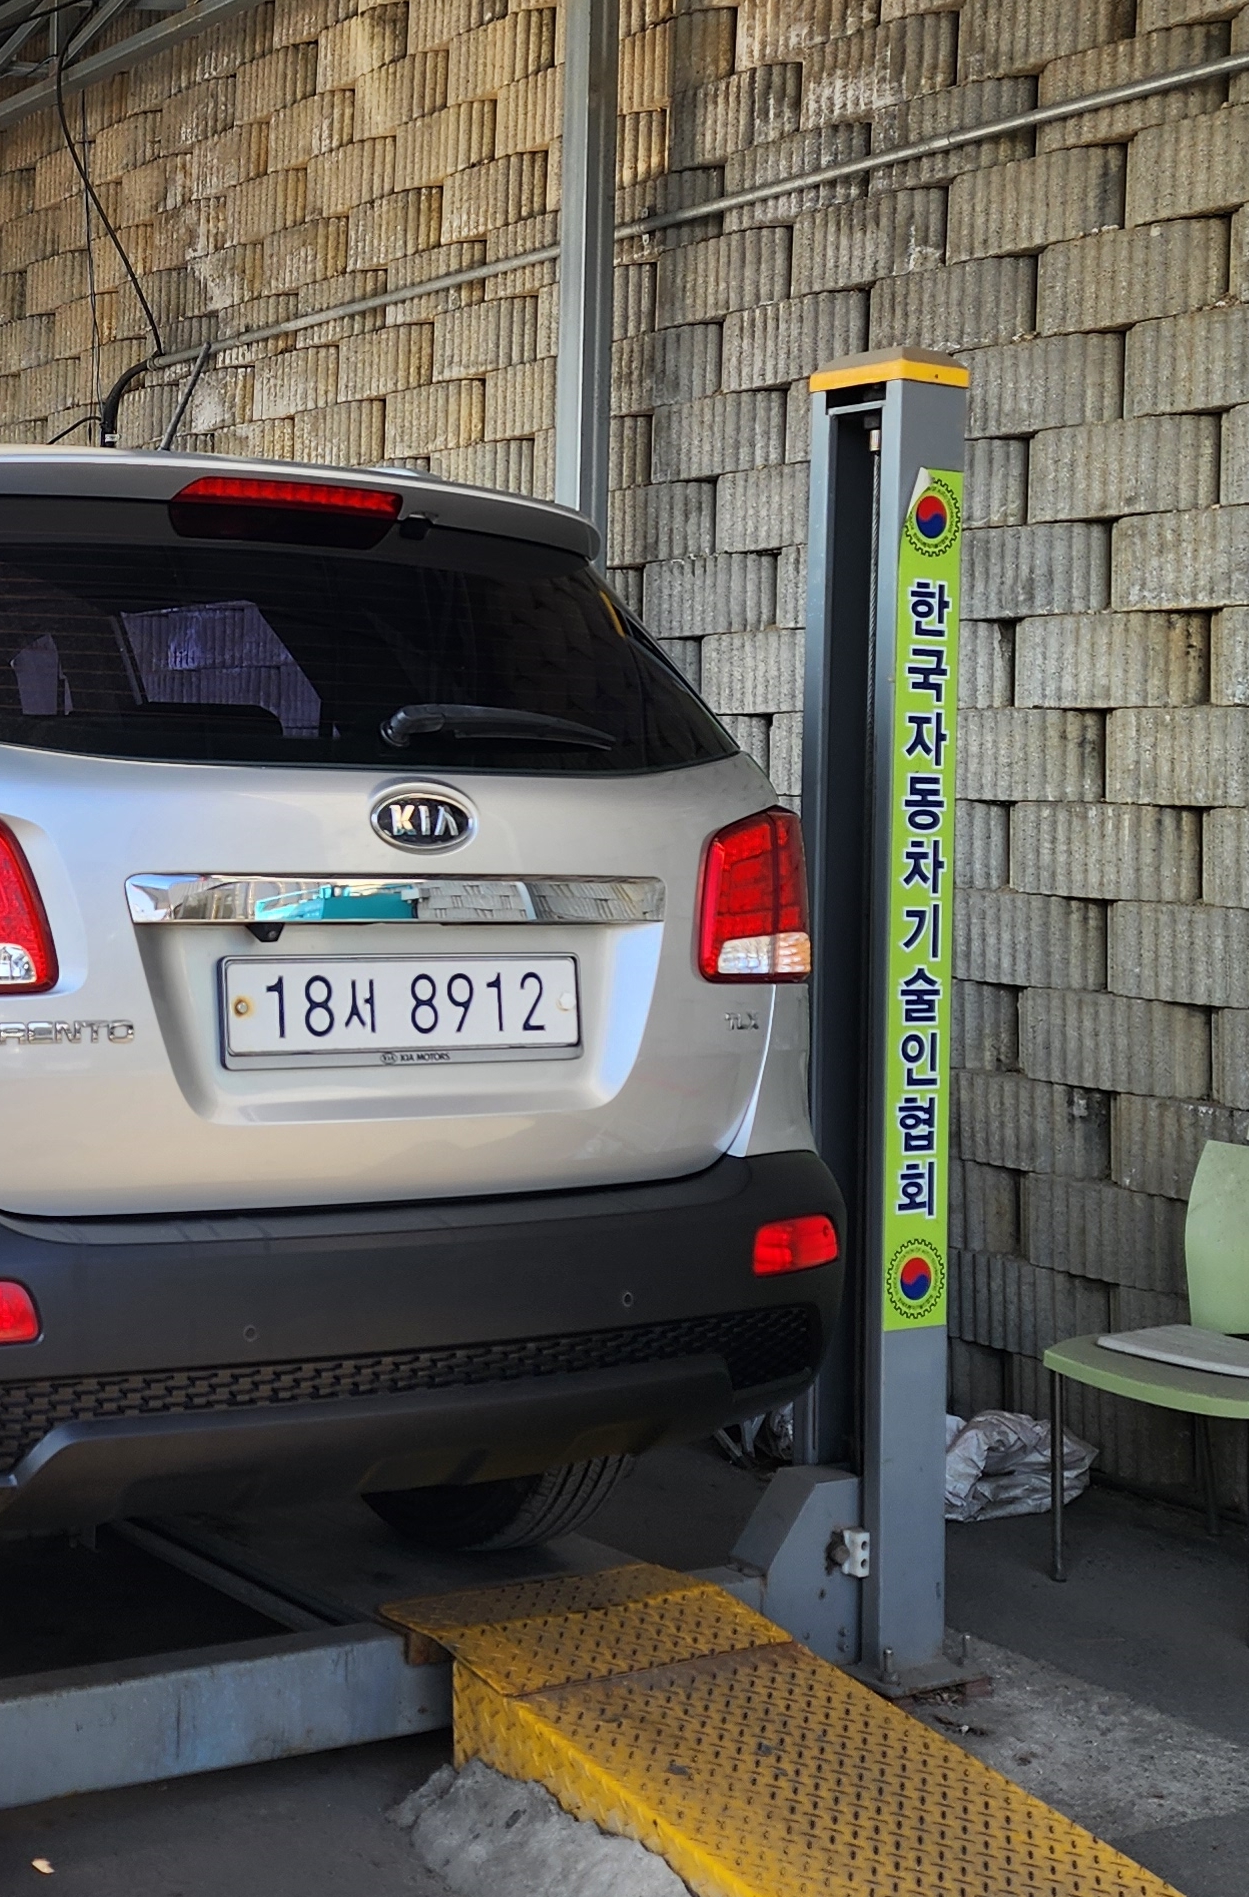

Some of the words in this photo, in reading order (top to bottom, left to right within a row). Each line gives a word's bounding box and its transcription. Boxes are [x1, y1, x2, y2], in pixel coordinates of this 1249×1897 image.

[388, 804, 459, 836] KIA
[898, 581, 949, 1217] 한국자동차기술인협회
[265, 974, 377, 1039] 18서
[410, 971, 547, 1036] 8912
[416, 1052, 451, 1061] MOTORS
